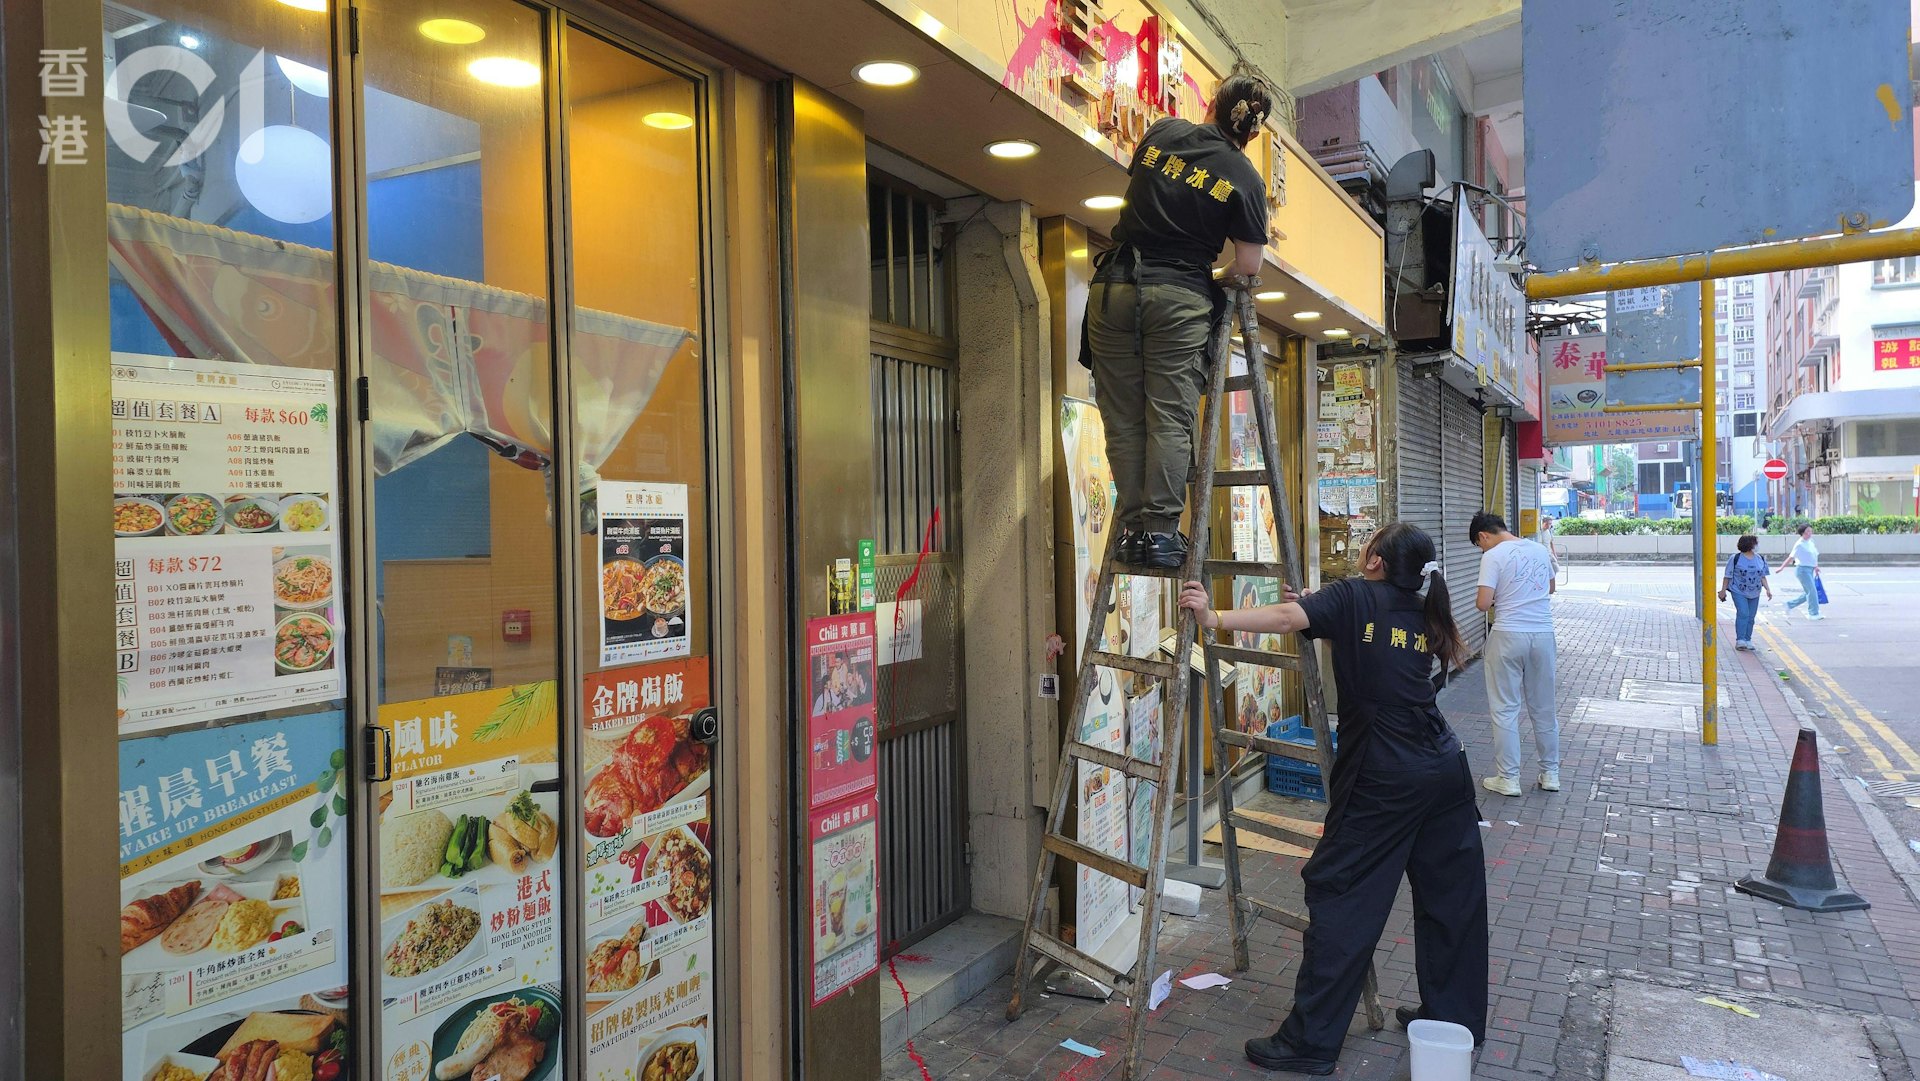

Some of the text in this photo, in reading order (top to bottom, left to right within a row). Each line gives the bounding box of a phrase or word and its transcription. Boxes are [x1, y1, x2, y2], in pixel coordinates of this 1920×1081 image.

[1141, 145, 1235, 203] 皇牌冰廳
[245, 407, 308, 426] 每款 $60
[227, 433, 242, 441] A06
[148, 556, 222, 574] 每款 $72
[147, 584, 163, 593] B01
[150, 626, 166, 634] B04
[819, 624, 838, 641] Chill
[150, 640, 167, 648] B05
[150, 654, 167, 662] B06
[150, 667, 166, 675] B07
[150, 681, 166, 689] B08
[592, 672, 684, 719] 金牌焗飯
[592, 713, 646, 732] BAKED RICE
[394, 711, 459, 758] 風味
[394, 754, 442, 774] FLAVOR
[120, 774, 297, 858] WAKE UP BREAKFAST
[200, 825, 228, 841] HONG
[229, 813, 255, 829] KONG
[257, 801, 280, 817] STYLE
[281, 788, 311, 807] FLAVOR
[821, 813, 841, 833] Chill
[517, 870, 551, 901] 港式
[490, 897, 551, 932] 炒粉麵飯
[491, 917, 552, 944] HONG KONG STYLE
[501, 927, 552, 949] FRIED NOODLES
[521, 934, 552, 950] AND RICE
[169, 974, 185, 986] 1201
[196, 947, 266, 978] 牛角酥炒蛋全餐
[196, 973, 223, 987] Croissant
[590, 993, 701, 1055] SIGNATURE SPECIAL MALAY CURRY
